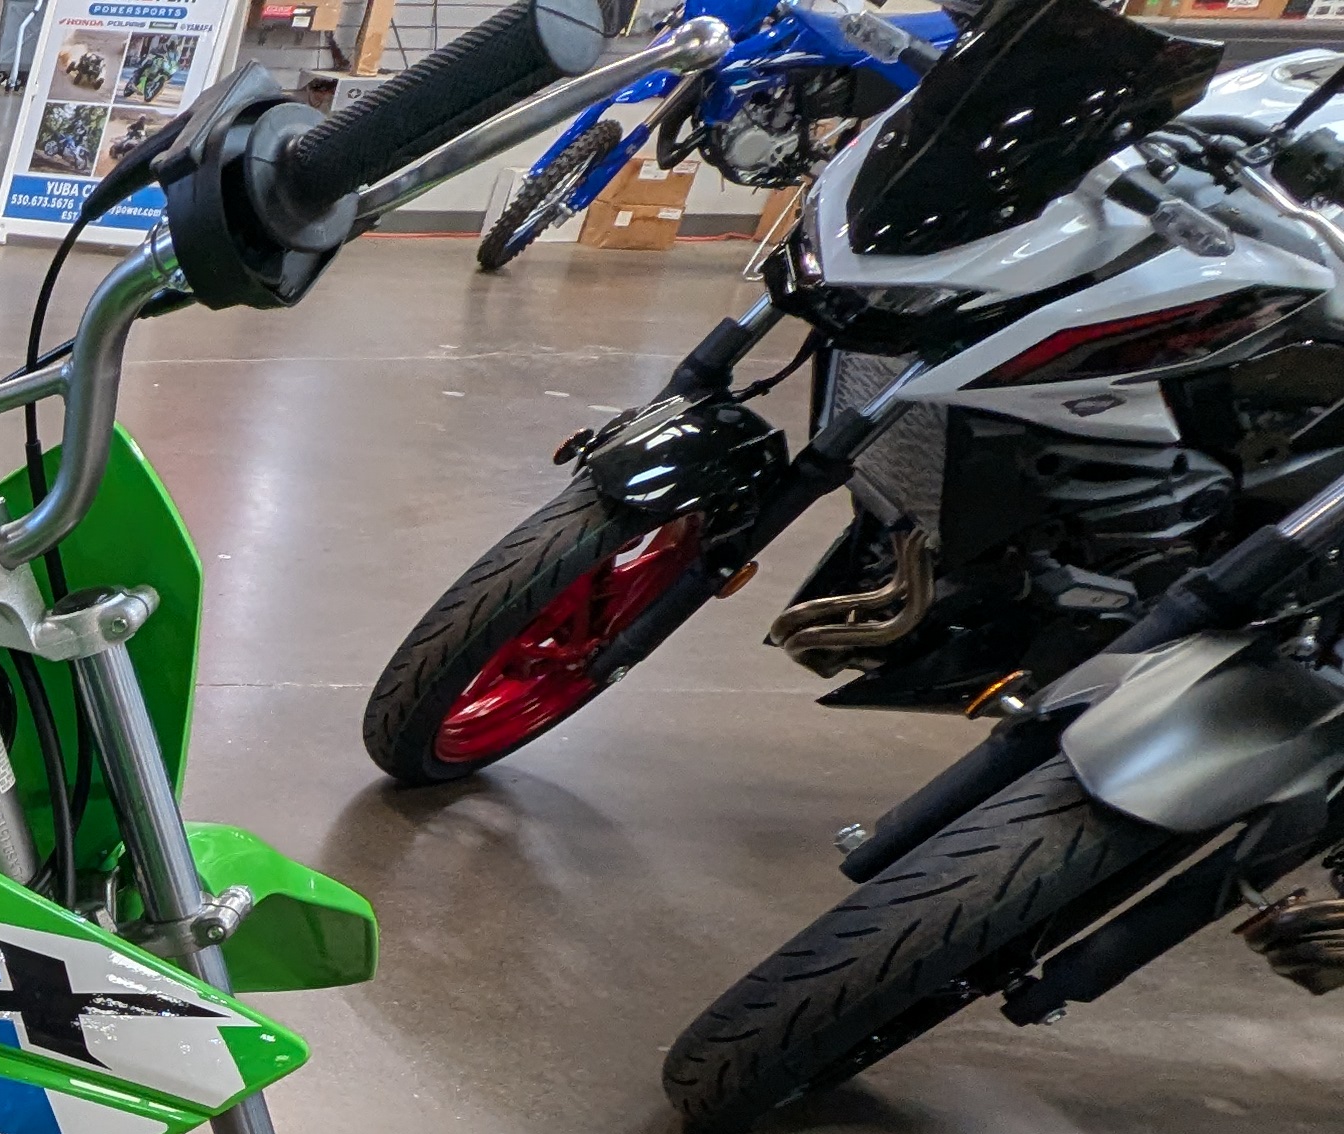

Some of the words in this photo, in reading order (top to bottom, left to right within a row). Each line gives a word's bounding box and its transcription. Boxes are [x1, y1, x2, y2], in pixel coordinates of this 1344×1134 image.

[93, 5, 182, 17] POWERSPORTS
[66, 18, 104, 27] HONDA
[46, 181, 79, 196] YUBA
[11, 194, 74, 209] 530.673.5676
